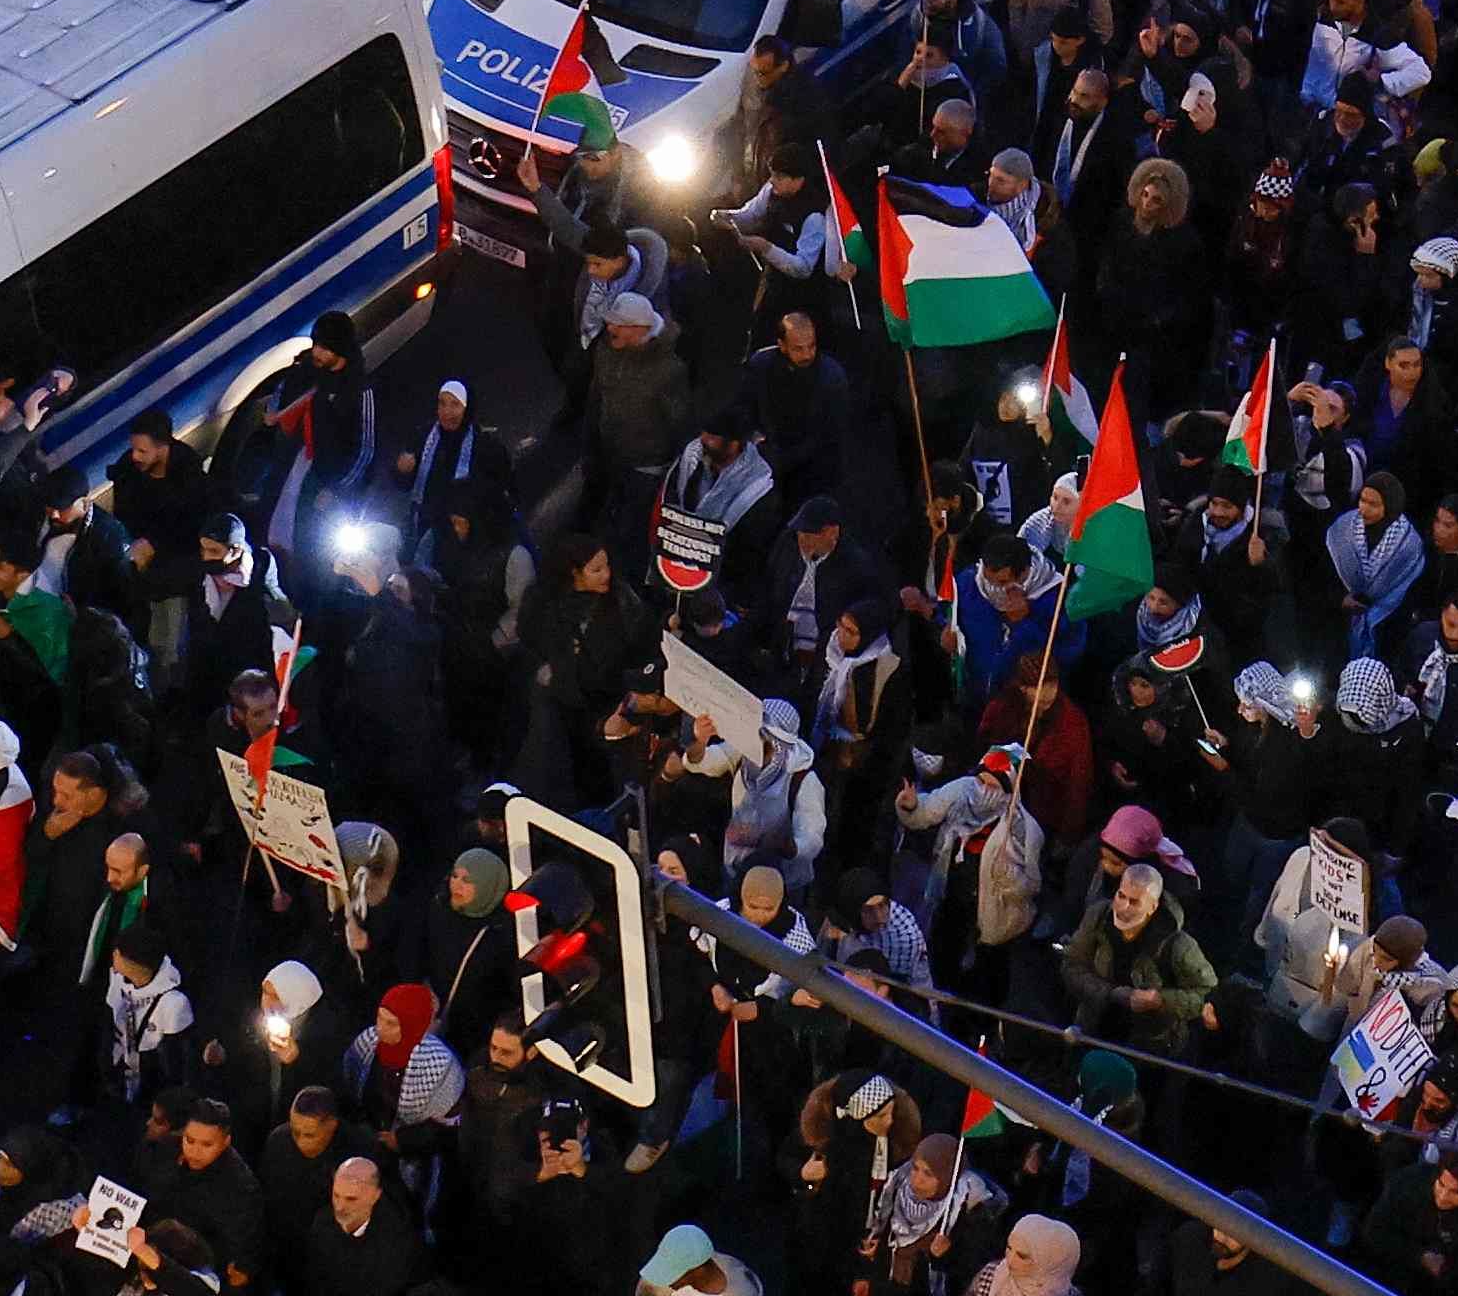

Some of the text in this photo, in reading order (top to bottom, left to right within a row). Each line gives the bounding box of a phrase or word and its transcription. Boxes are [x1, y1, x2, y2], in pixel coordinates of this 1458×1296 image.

[406, 213, 428, 243] 15
[99, 1184, 139, 1210] NO WAR
